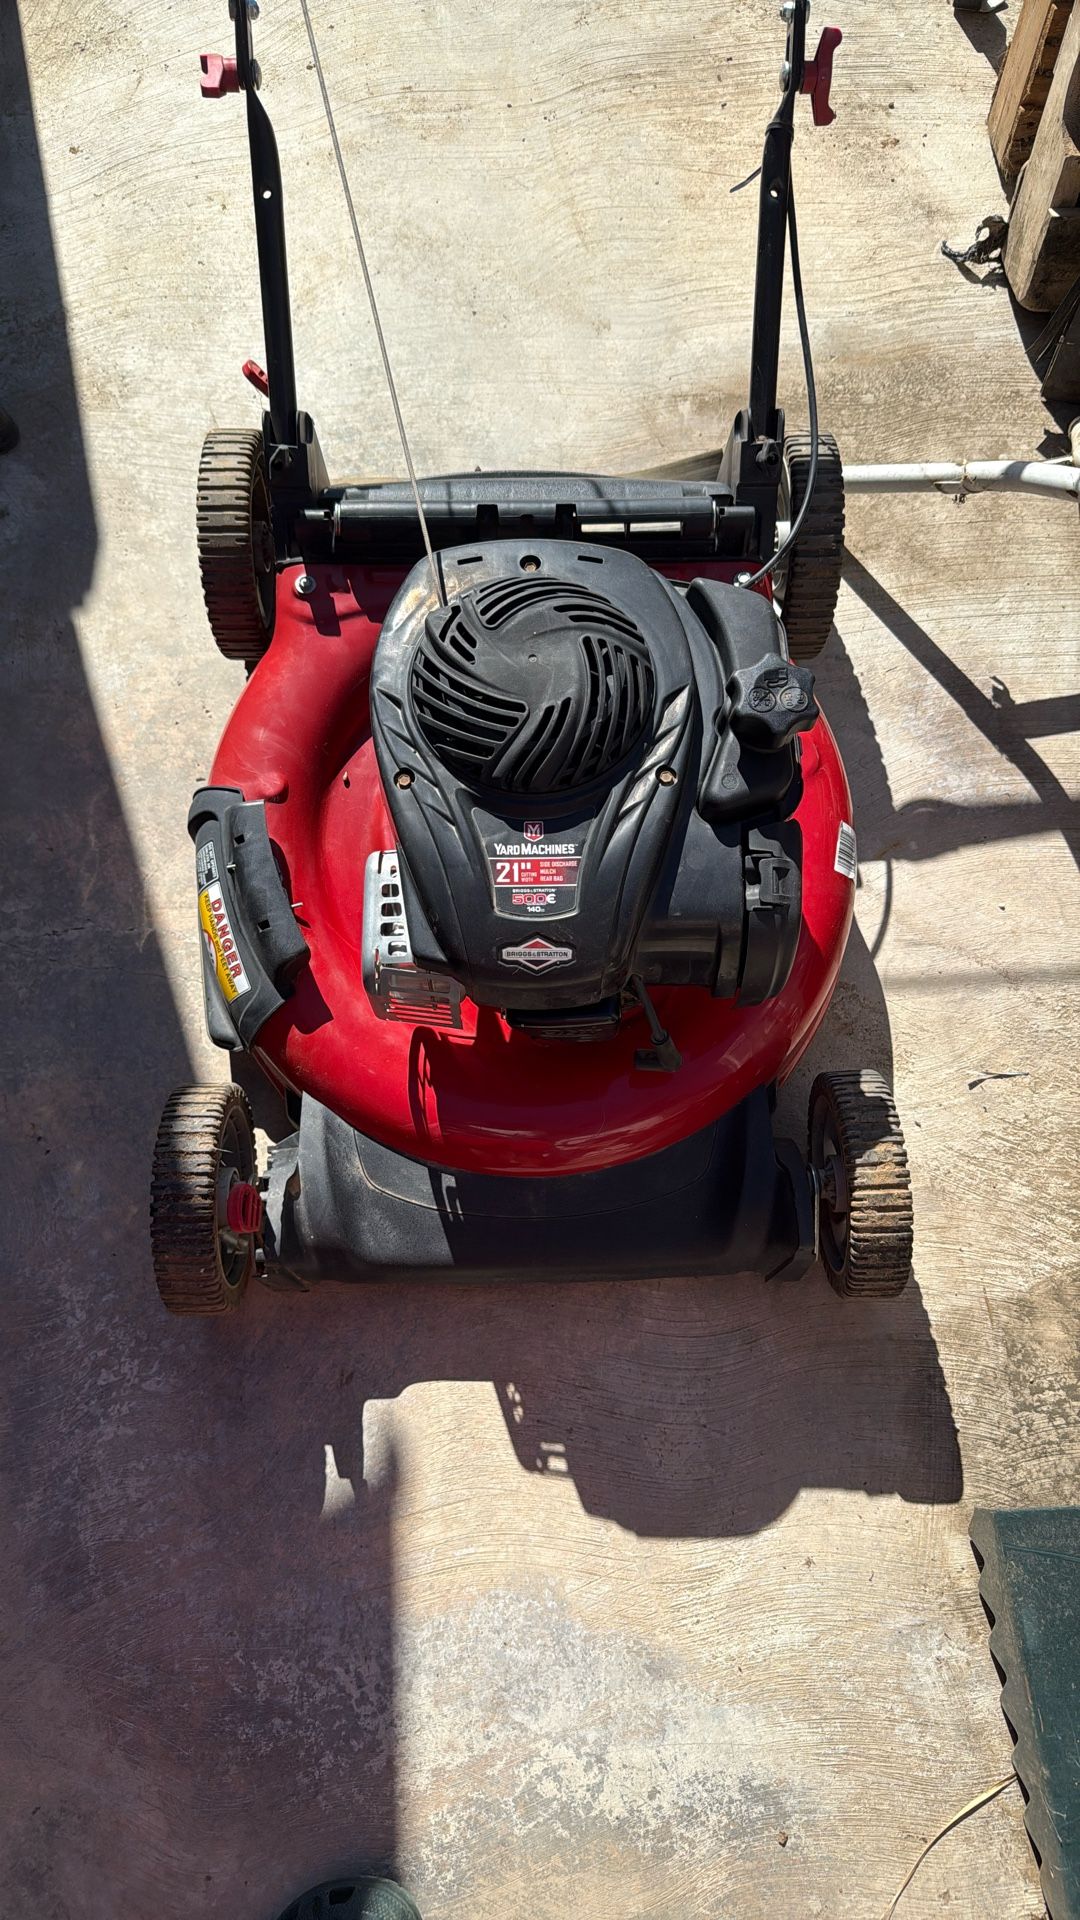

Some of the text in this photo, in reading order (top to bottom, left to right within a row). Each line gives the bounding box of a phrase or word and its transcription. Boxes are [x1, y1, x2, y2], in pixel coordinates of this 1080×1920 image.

[204, 893, 212, 913] KEEP
[209, 914, 218, 938] HANDS
[215, 939, 223, 953] and
[219, 952, 229, 971] FEET
[225, 972, 238, 994] AWAY
[211, 898, 243, 979] DANGER
